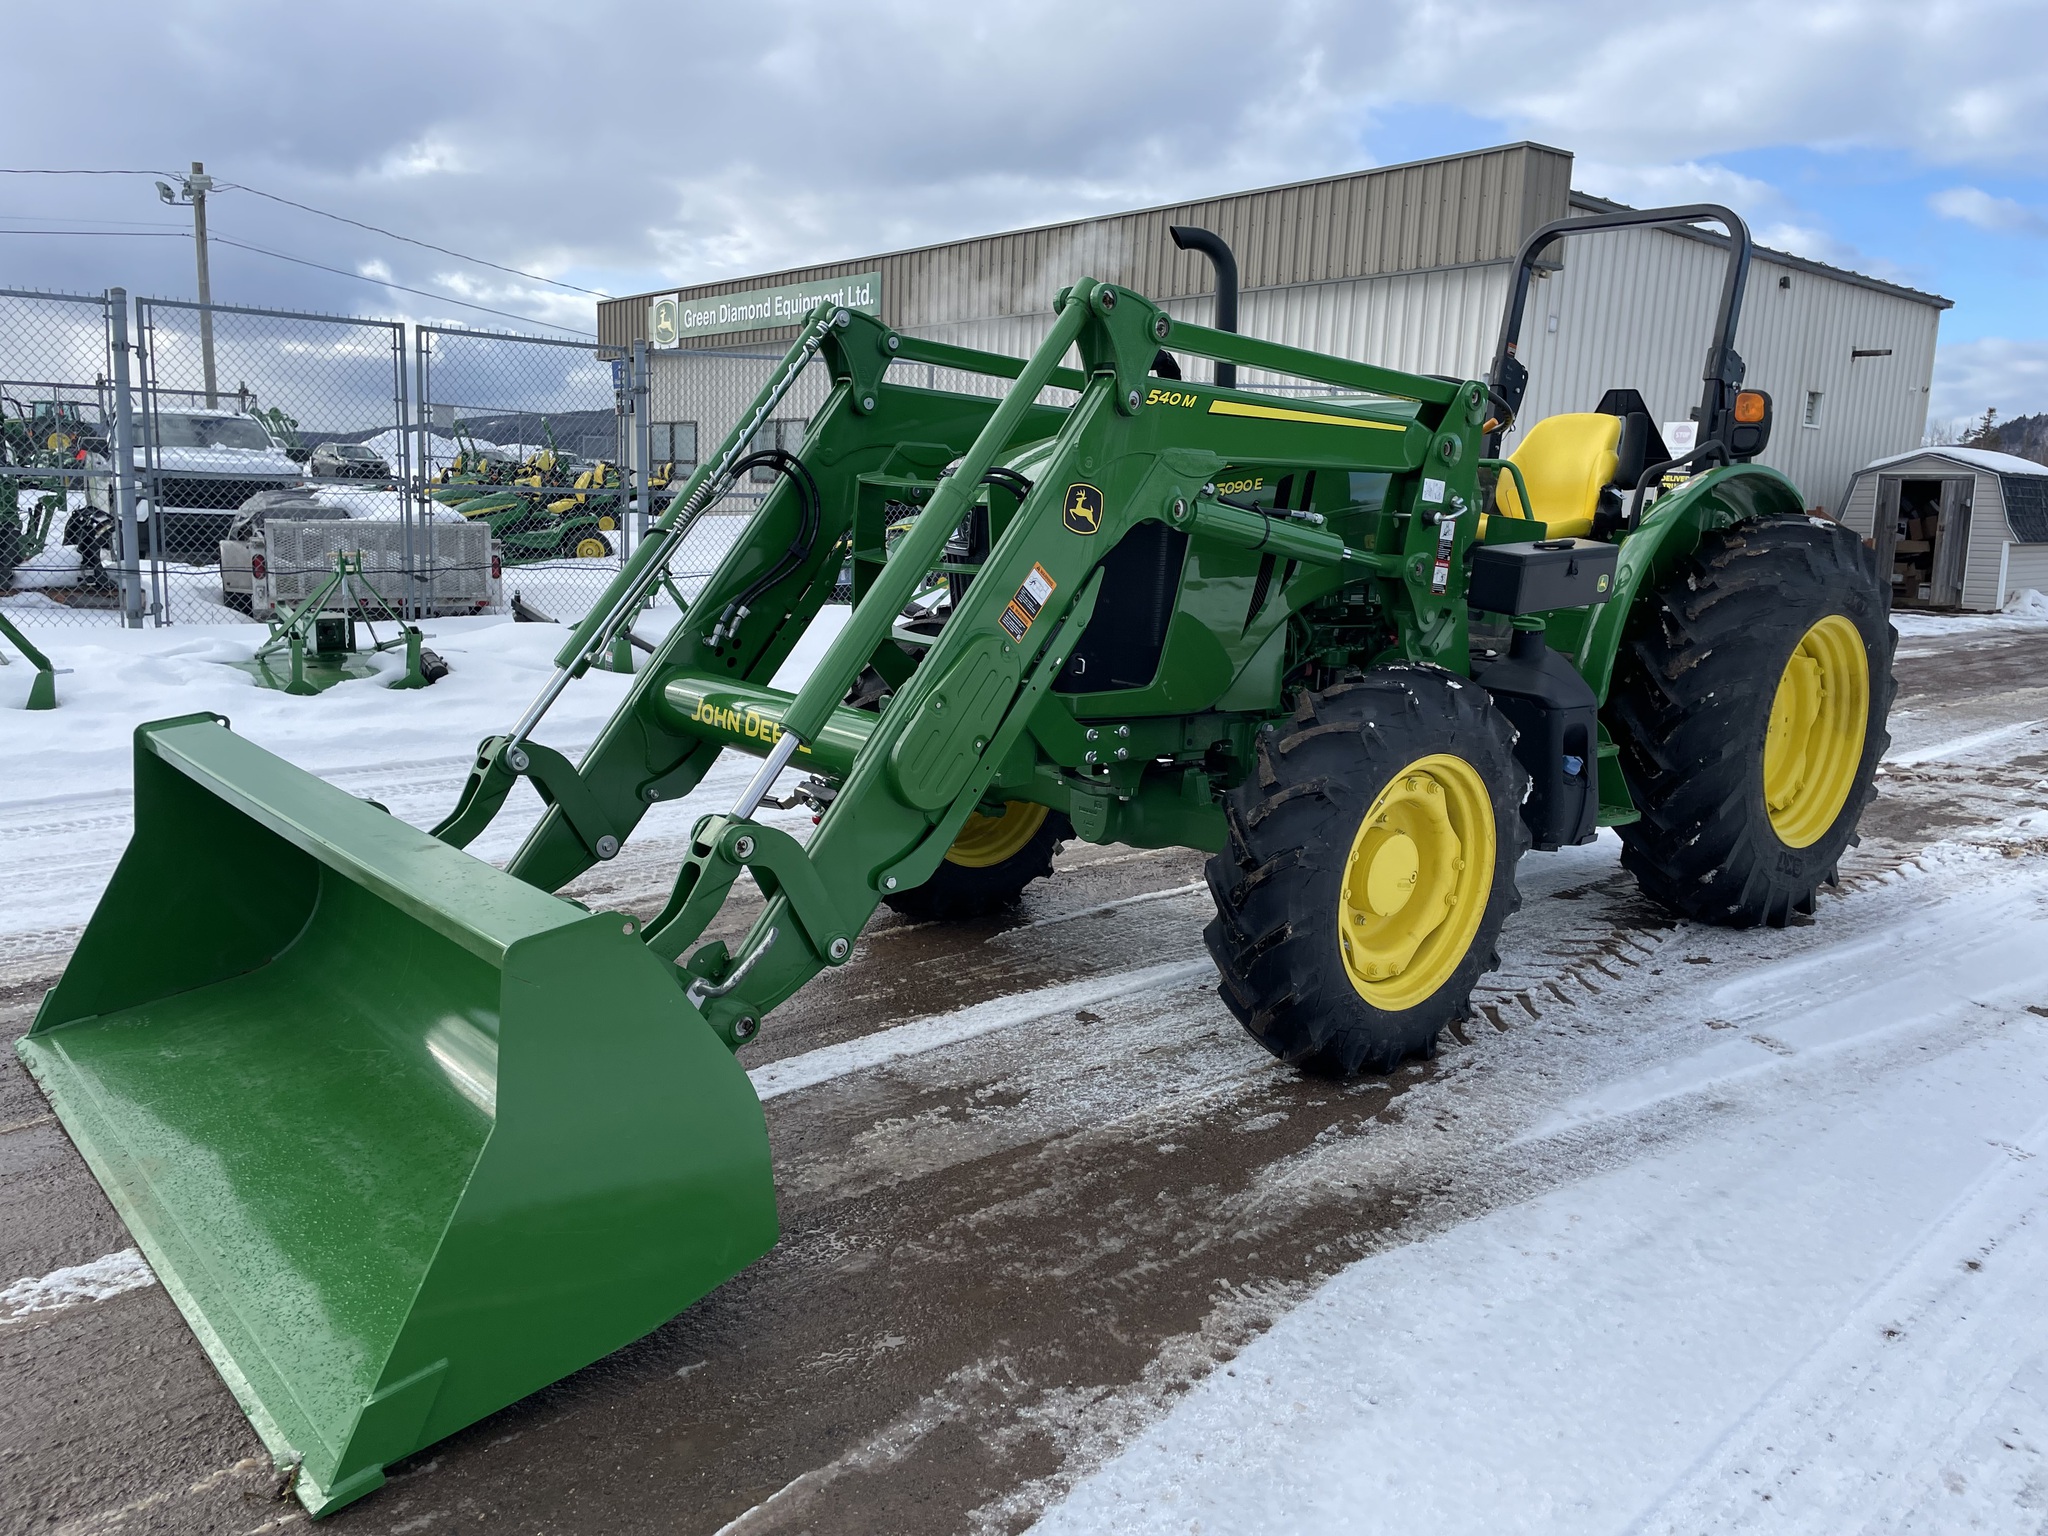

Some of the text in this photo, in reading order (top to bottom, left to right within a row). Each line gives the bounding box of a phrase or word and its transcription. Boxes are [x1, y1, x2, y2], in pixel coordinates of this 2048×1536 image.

[684, 309, 716, 328] Green
[719, 297, 771, 324] Diamond
[848, 282, 874, 307] Ltd.
[691, 697, 812, 754] JOHN DEE
